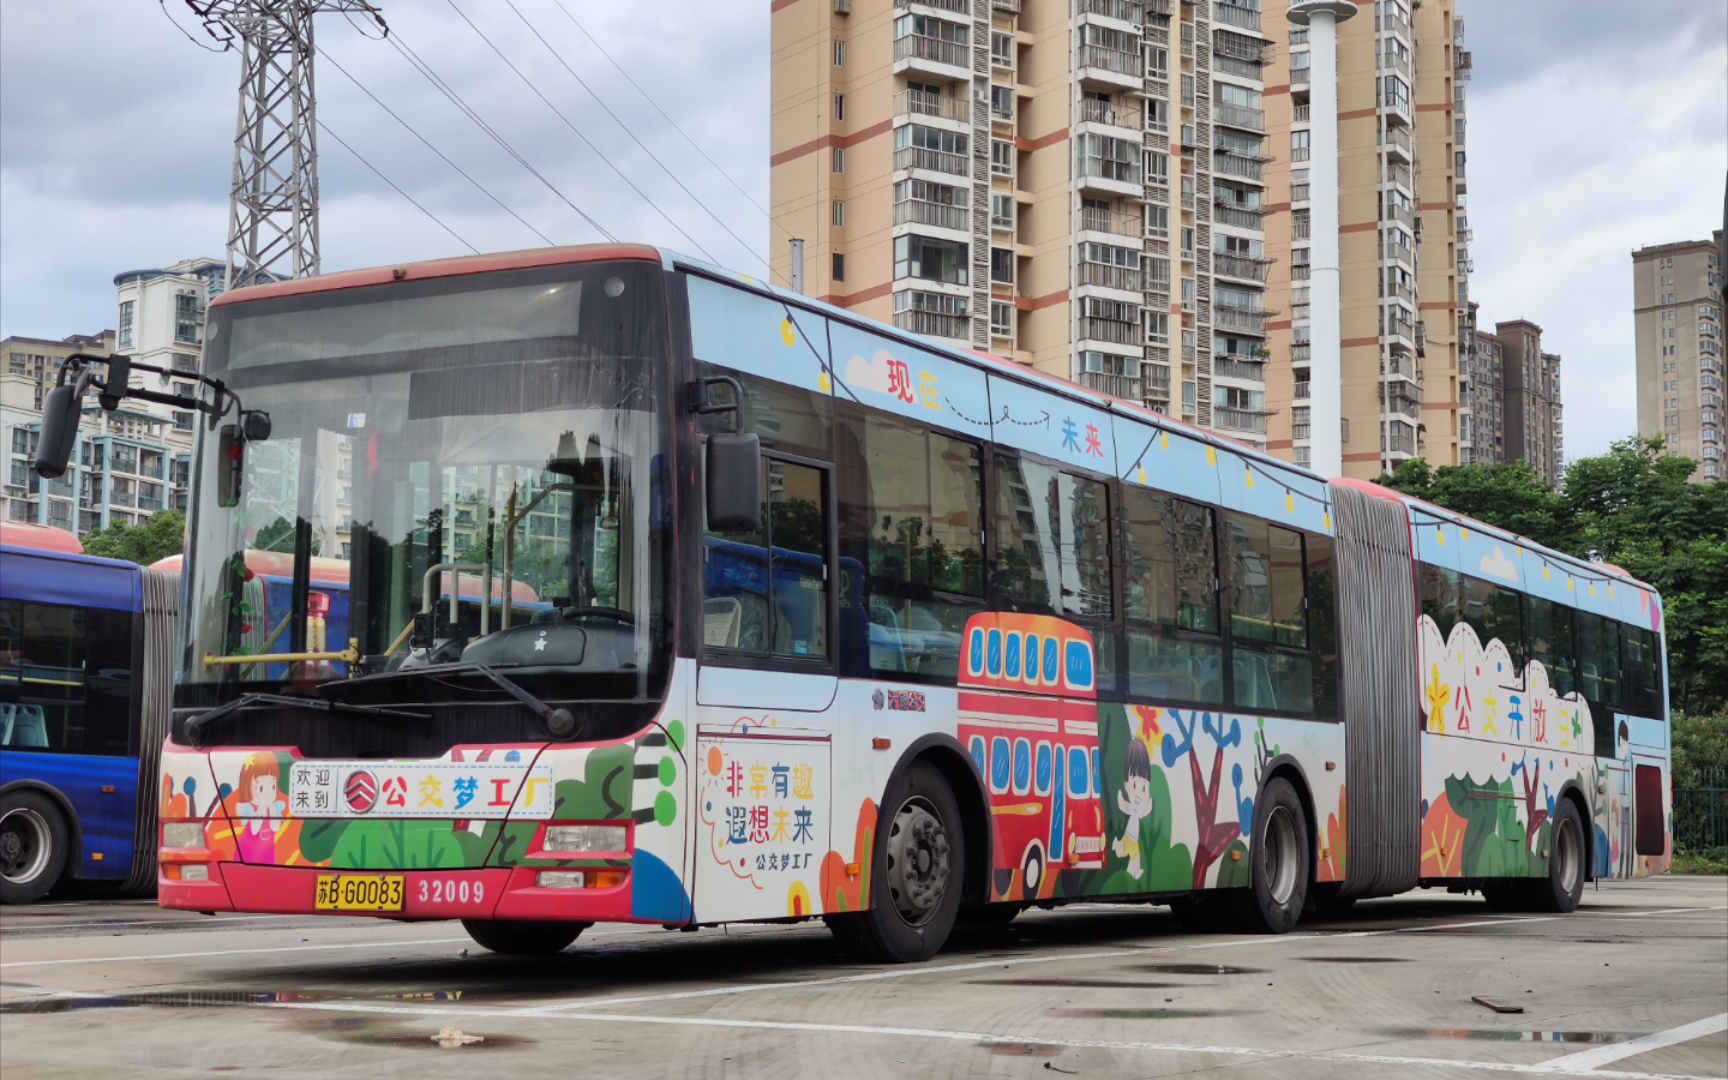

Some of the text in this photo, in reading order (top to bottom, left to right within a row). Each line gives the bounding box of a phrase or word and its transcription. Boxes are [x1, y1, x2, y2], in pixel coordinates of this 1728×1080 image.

[887, 359, 1104, 459] 现在 未来
[1455, 685, 1569, 747] 公交开放日
[297, 768, 330, 787] 欢迎
[382, 774, 550, 810] 公交梦工厂
[726, 760, 814, 800] 非常有趣
[296, 790, 329, 809] 来到
[726, 805, 814, 845] 遐想未来
[756, 852, 813, 871] 公交梦工厂
[418, 879, 484, 903] 32009
